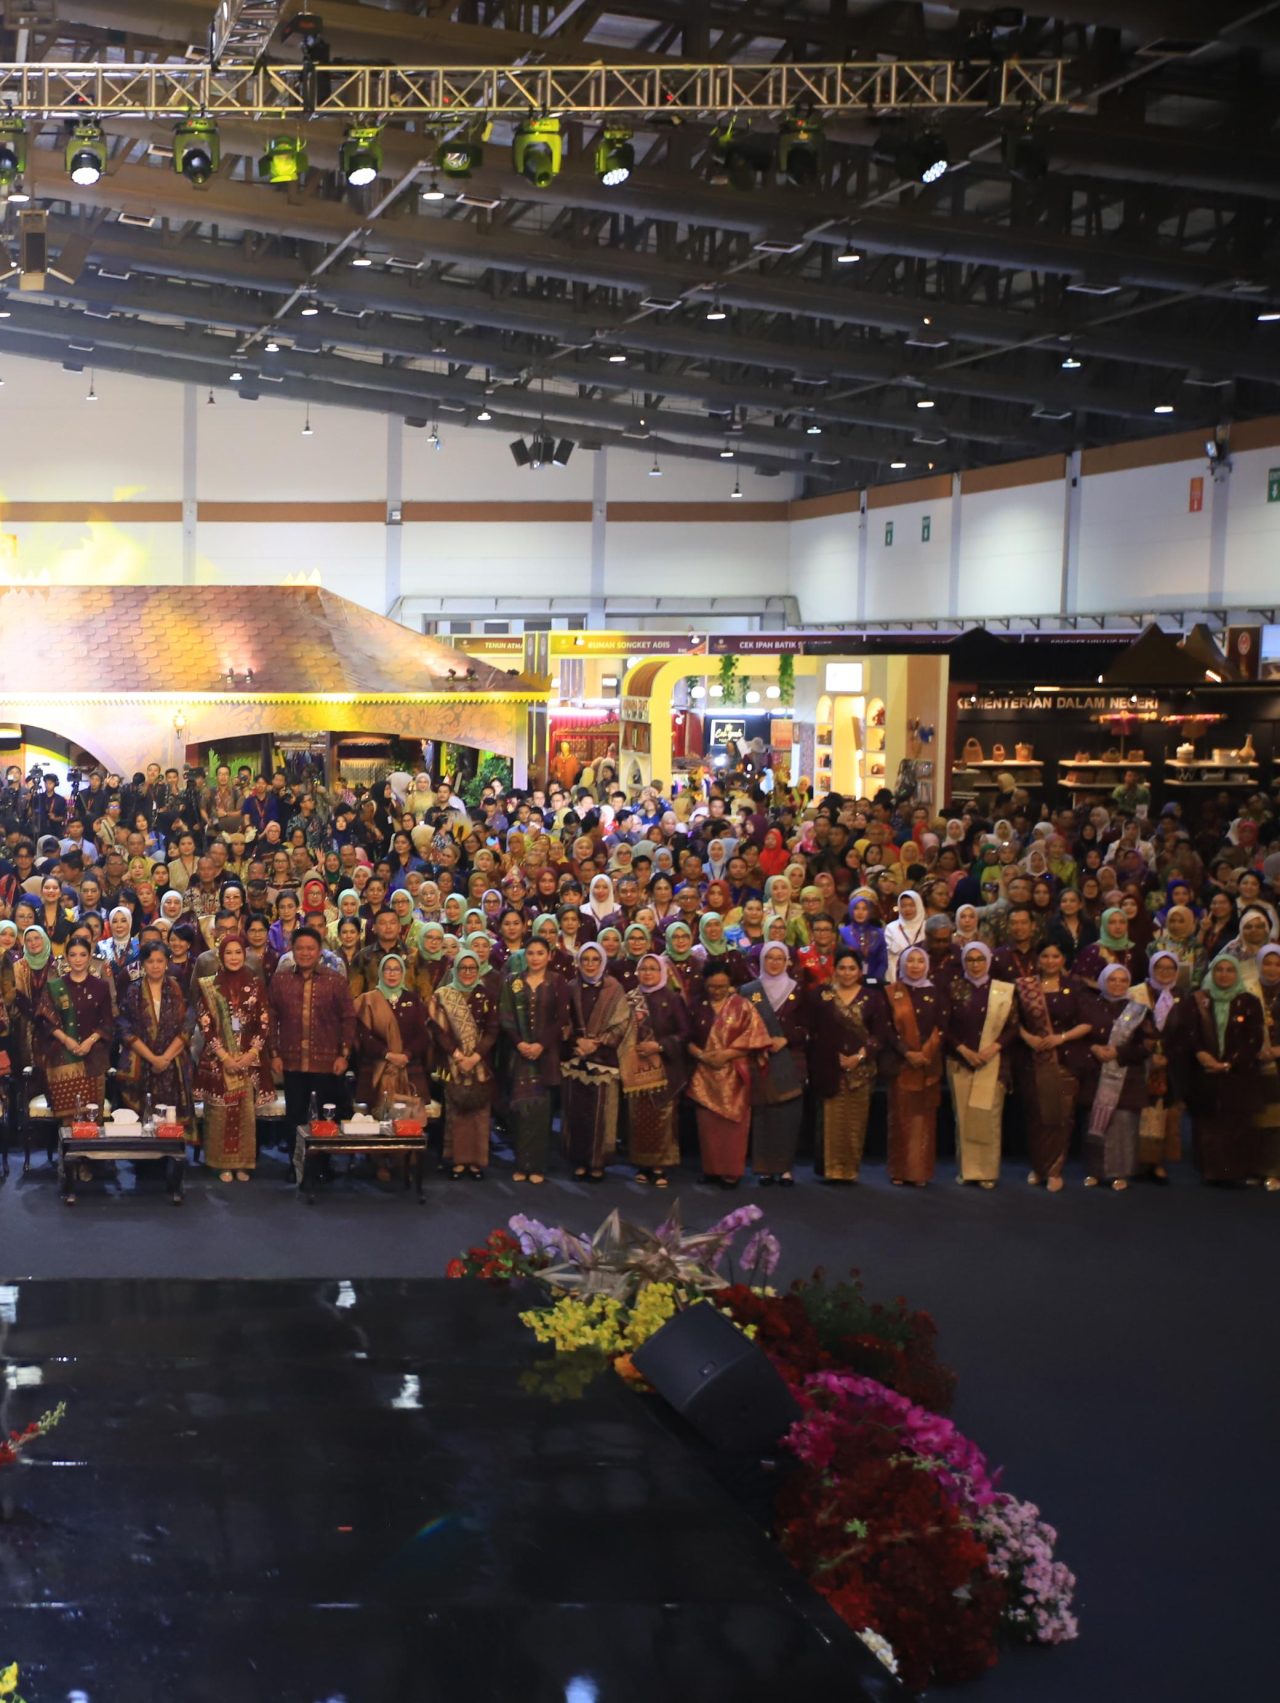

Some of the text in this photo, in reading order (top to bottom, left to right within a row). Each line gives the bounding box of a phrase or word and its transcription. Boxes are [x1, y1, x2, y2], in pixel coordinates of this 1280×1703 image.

[617, 641, 650, 649] SONGKET
[774, 641, 797, 649] BATIK
[957, 697, 1158, 709] KEMENTERIAN DALAM NEGERI
